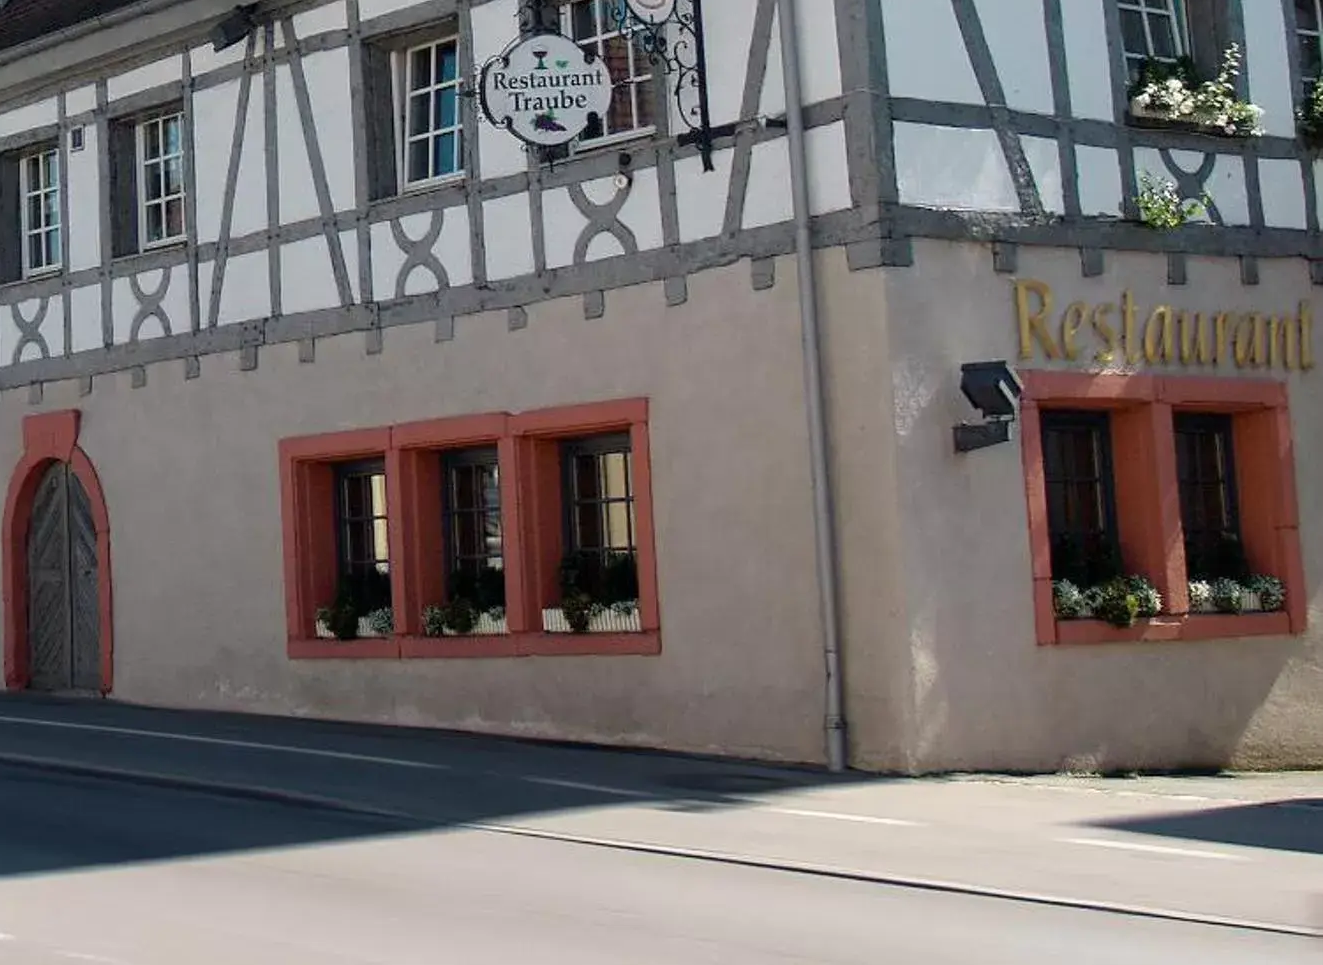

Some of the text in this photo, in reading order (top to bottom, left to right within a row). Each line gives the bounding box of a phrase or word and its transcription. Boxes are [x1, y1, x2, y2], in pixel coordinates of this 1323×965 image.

[493, 70, 602, 89] Restaurant
[508, 90, 588, 111] Traube
[1013, 278, 1315, 371] Restaurant
